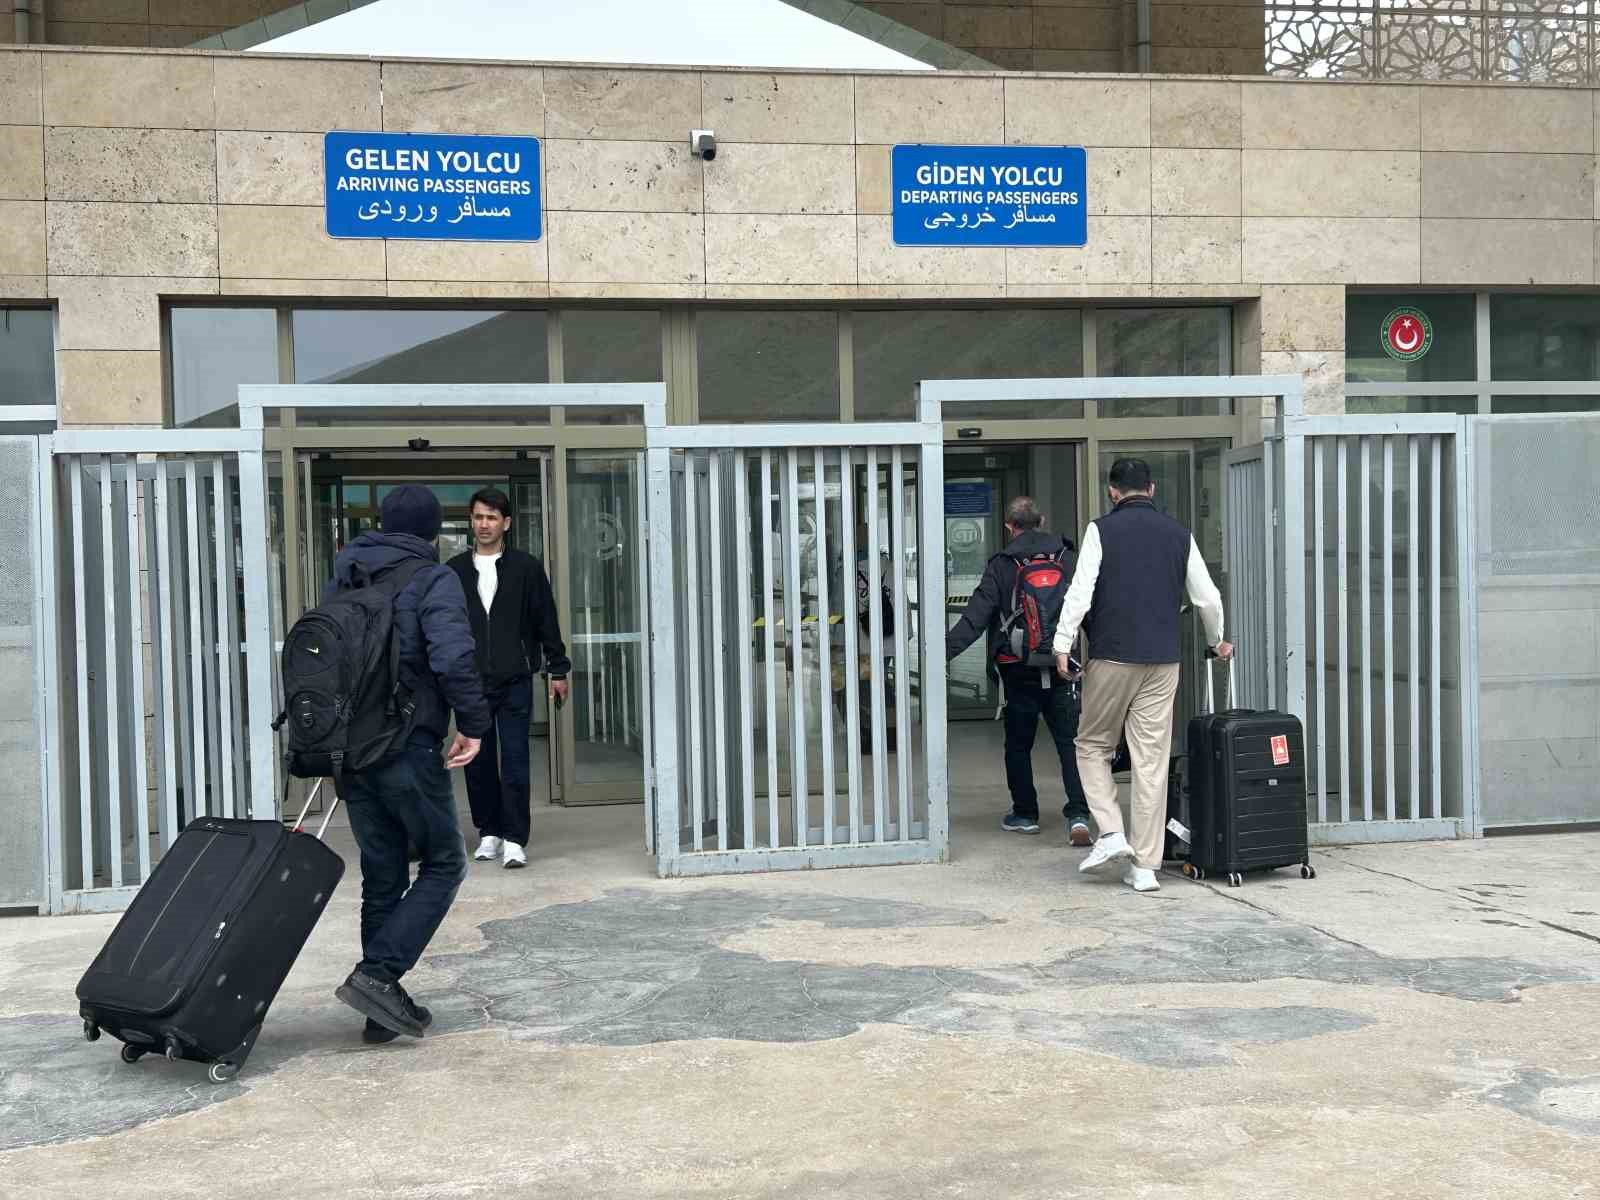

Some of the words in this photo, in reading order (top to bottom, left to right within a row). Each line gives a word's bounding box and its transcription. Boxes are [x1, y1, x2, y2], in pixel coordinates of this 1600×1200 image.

[345, 148, 429, 172] GELEN
[437, 151, 521, 174] YOLCU
[336, 176, 419, 192] ARRIVING
[423, 178, 531, 195] PASSENGERS
[916, 161, 985, 185] GİDEN
[990, 166, 1063, 186] YOLCU
[447, 196, 511, 223] مسافر
[901, 190, 983, 204] DEPARTING
[987, 191, 1079, 205] PASSENGERS
[358, 199, 438, 222] ورودی
[1003, 205, 1056, 229] مسافر
